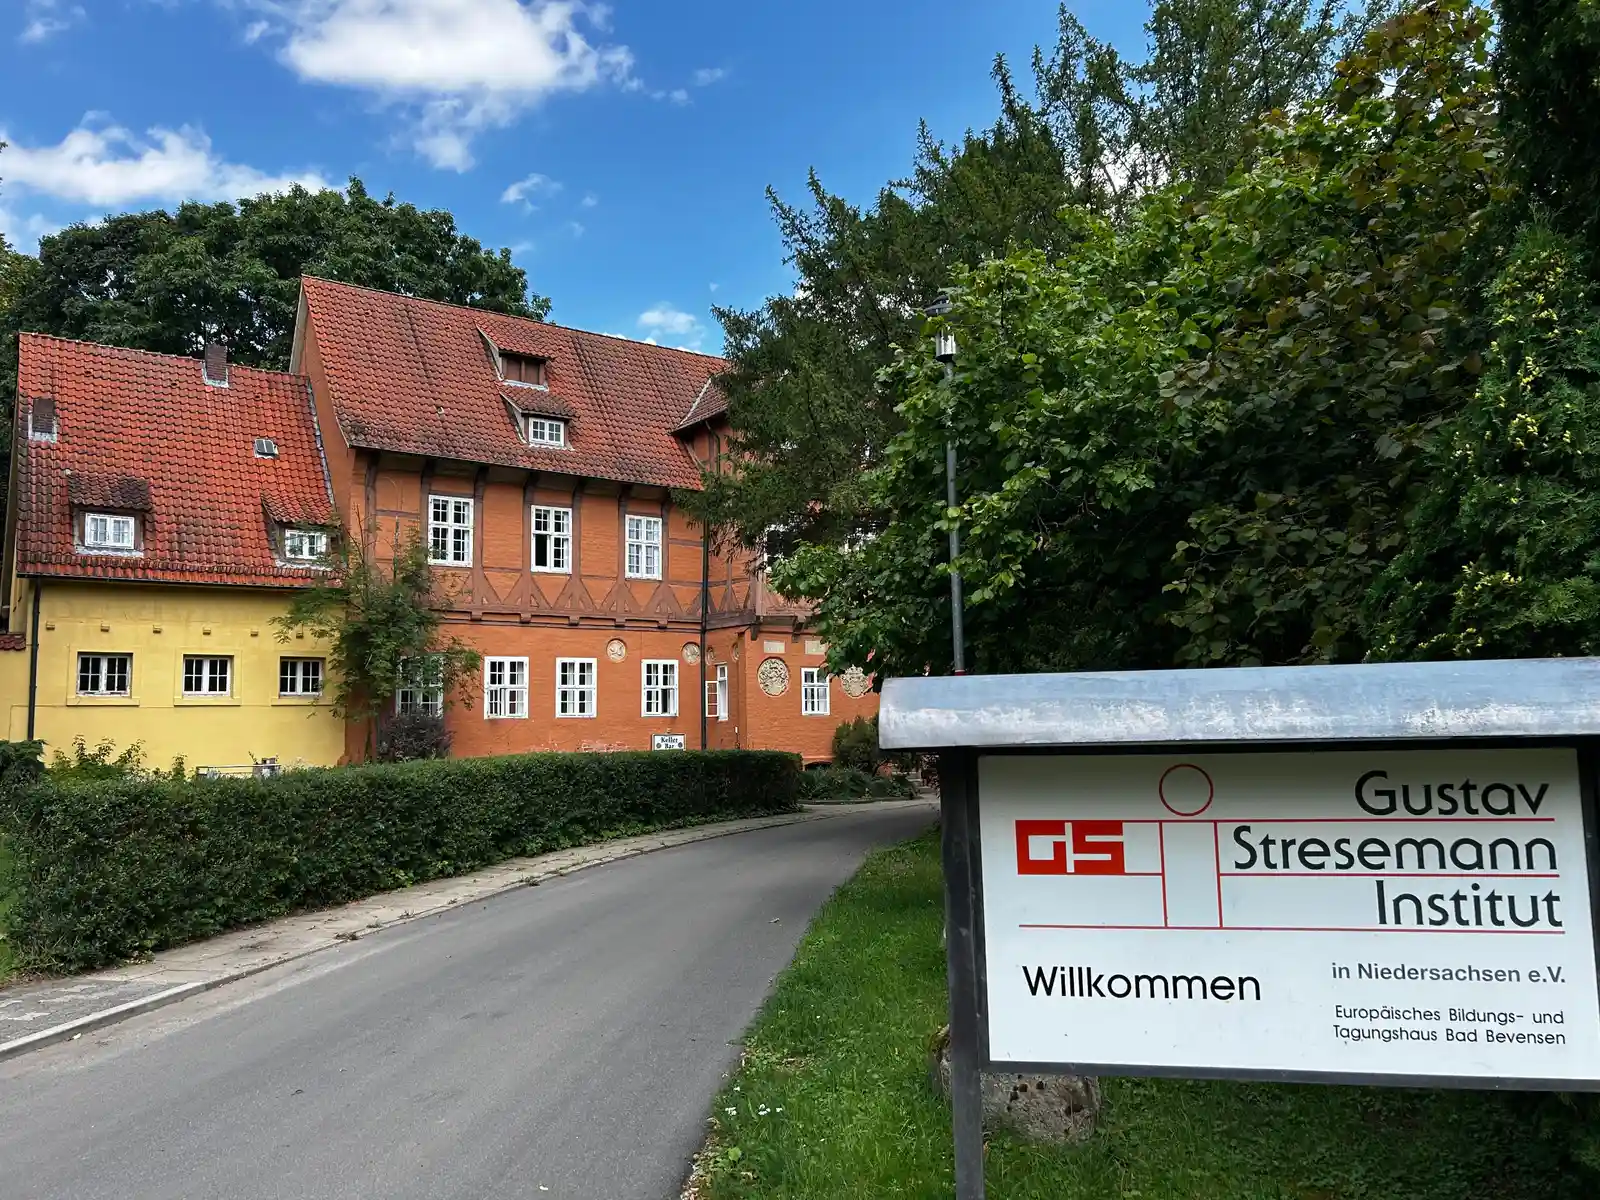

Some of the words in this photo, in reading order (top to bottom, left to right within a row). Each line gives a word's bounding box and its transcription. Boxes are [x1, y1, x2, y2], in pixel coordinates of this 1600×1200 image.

[1355, 770, 1549, 815] Gustav
[1233, 825, 1557, 870] Stresemann
[1376, 880, 1563, 927] Institut
[1022, 966, 1261, 1000] Willkommen
[1332, 963, 1350, 979] in
[1357, 963, 1521, 982] Niedersachsen
[1528, 966, 1566, 983] e.V.
[1335, 1005, 1441, 1021] Europäisches
[1449, 1008, 1524, 1025] Bildungs-
[1532, 1010, 1564, 1024] und
[1333, 1025, 1438, 1042] Tagungshaus
[1446, 1028, 1478, 1042] Bad
[1486, 1030, 1566, 1044] Bevensen
